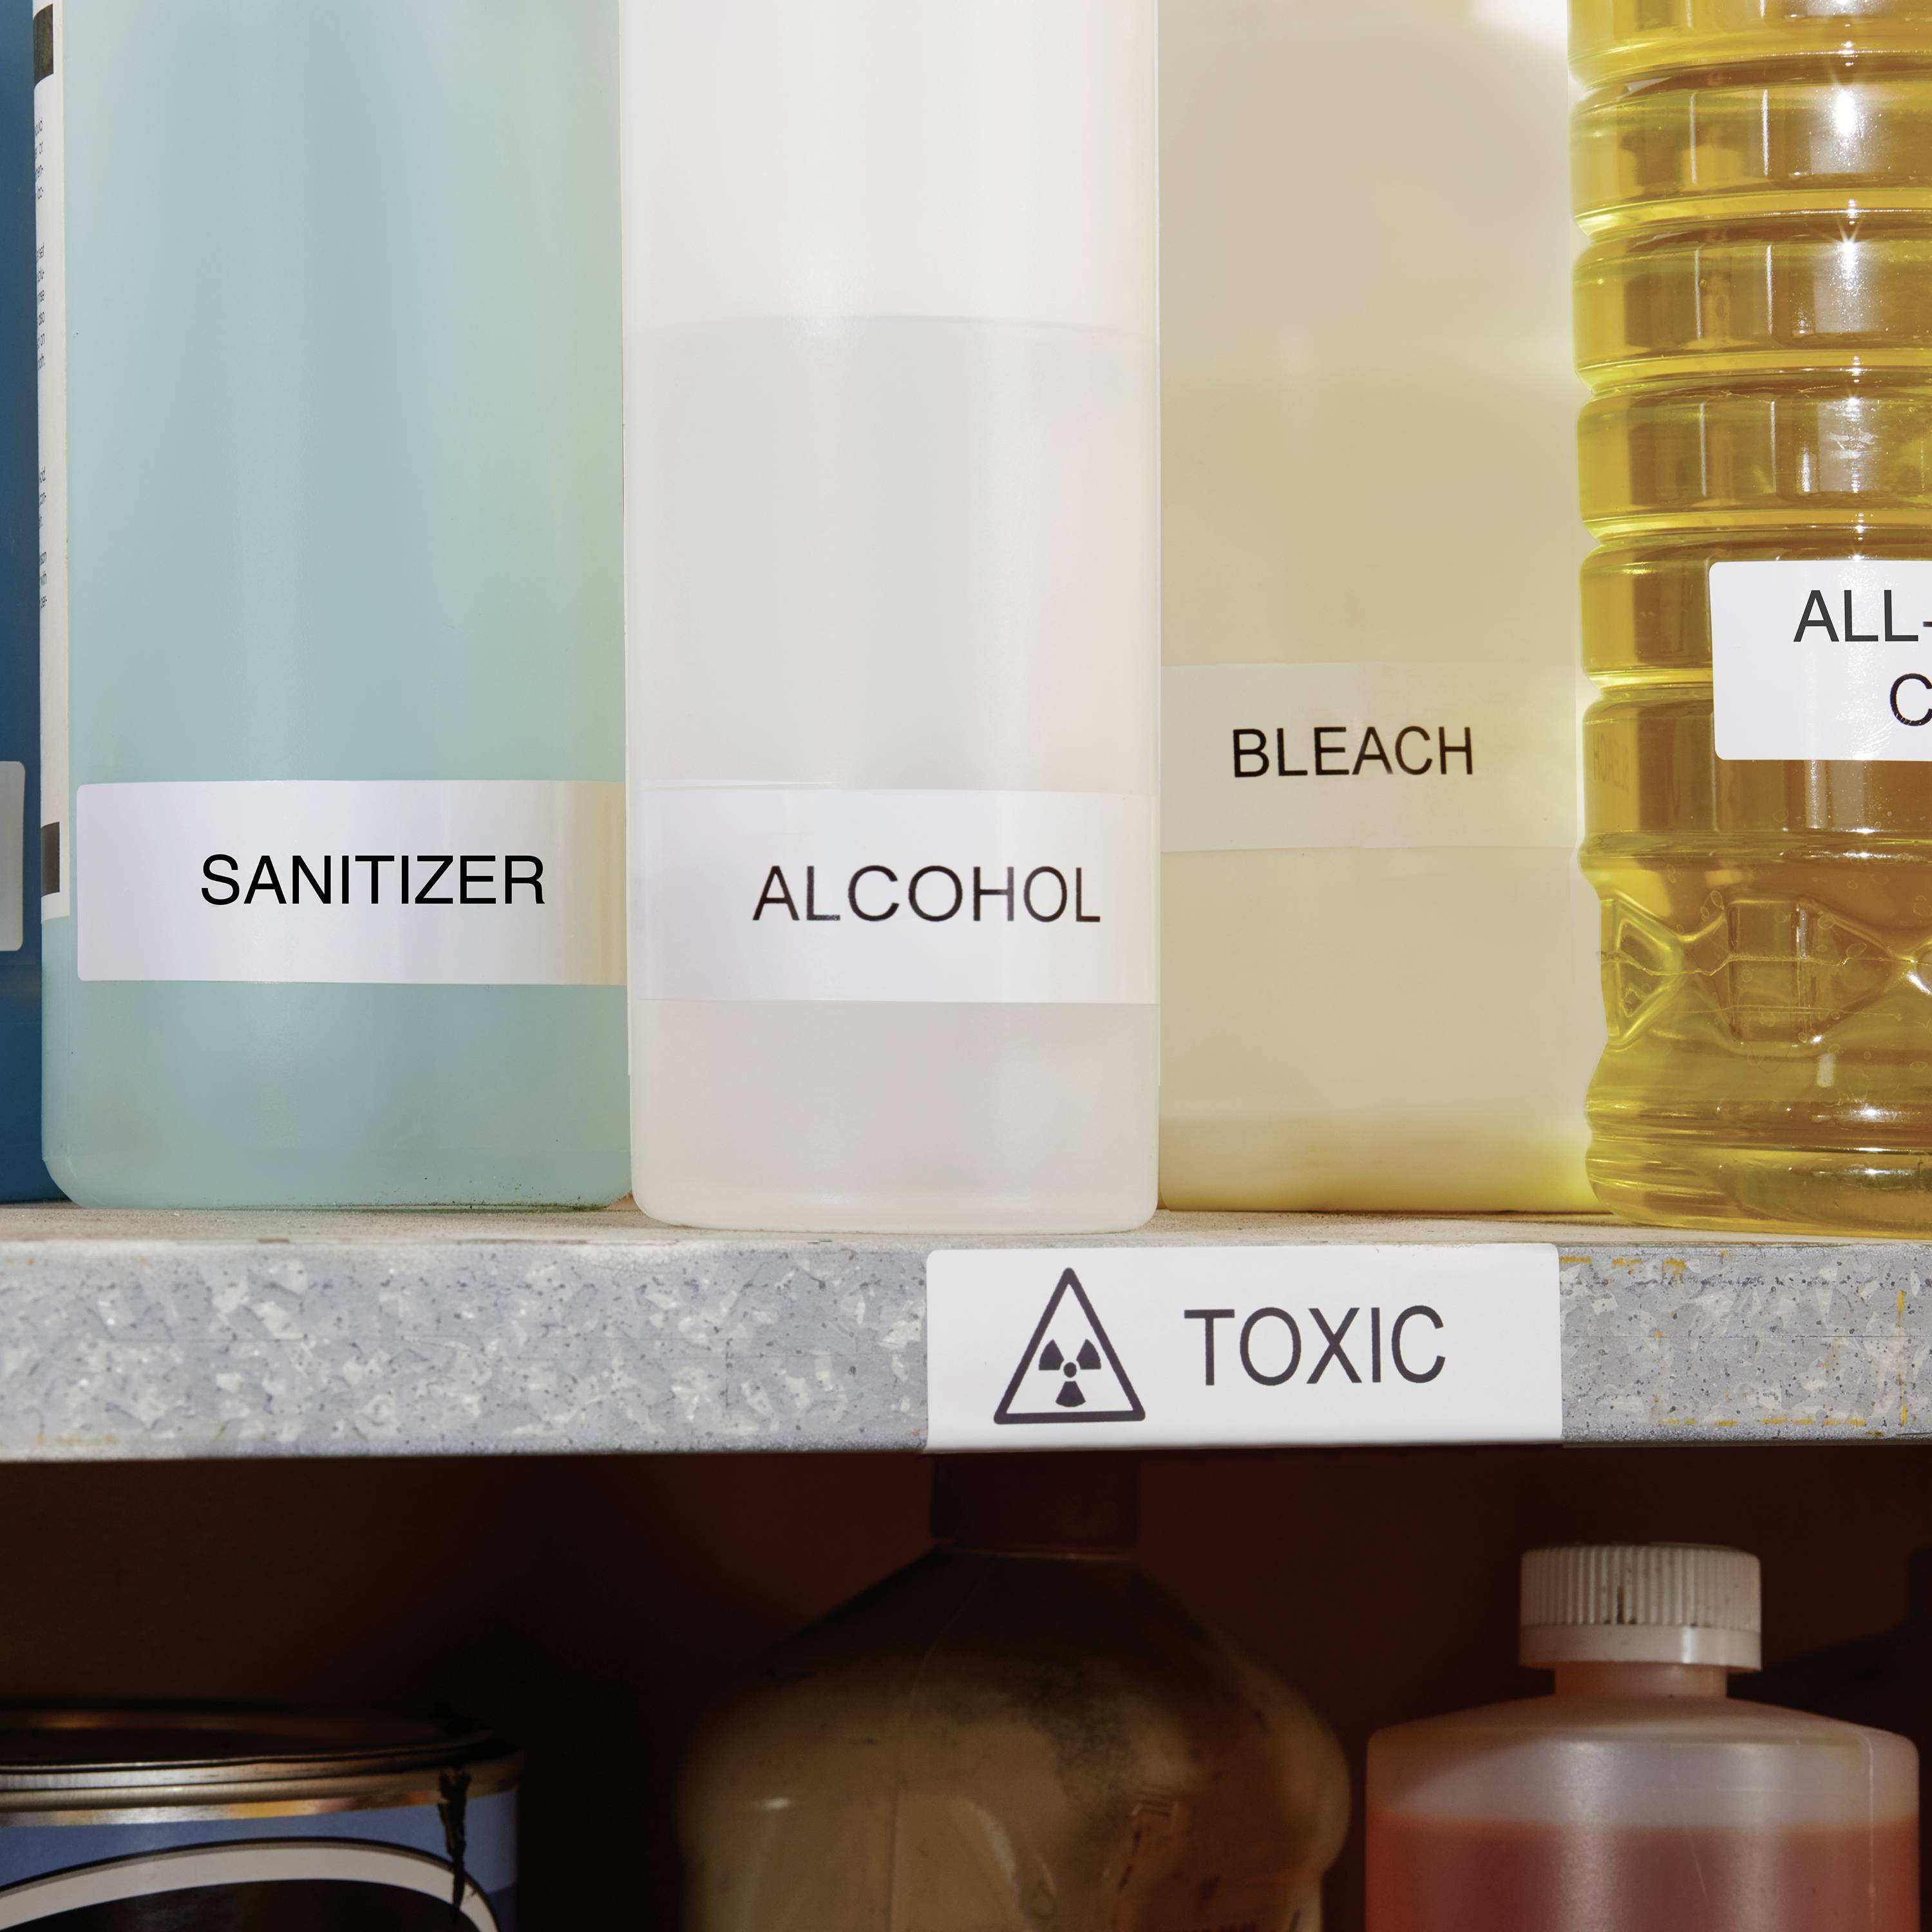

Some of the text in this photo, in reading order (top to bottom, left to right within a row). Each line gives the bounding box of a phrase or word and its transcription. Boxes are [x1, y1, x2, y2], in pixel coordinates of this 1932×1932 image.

[1233, 725, 1473, 778] BLEACH
[201, 853, 545, 905] SANITIZER
[752, 865, 1101, 923] ALCOHOL
[1184, 1305, 1446, 1386] TOXIC
